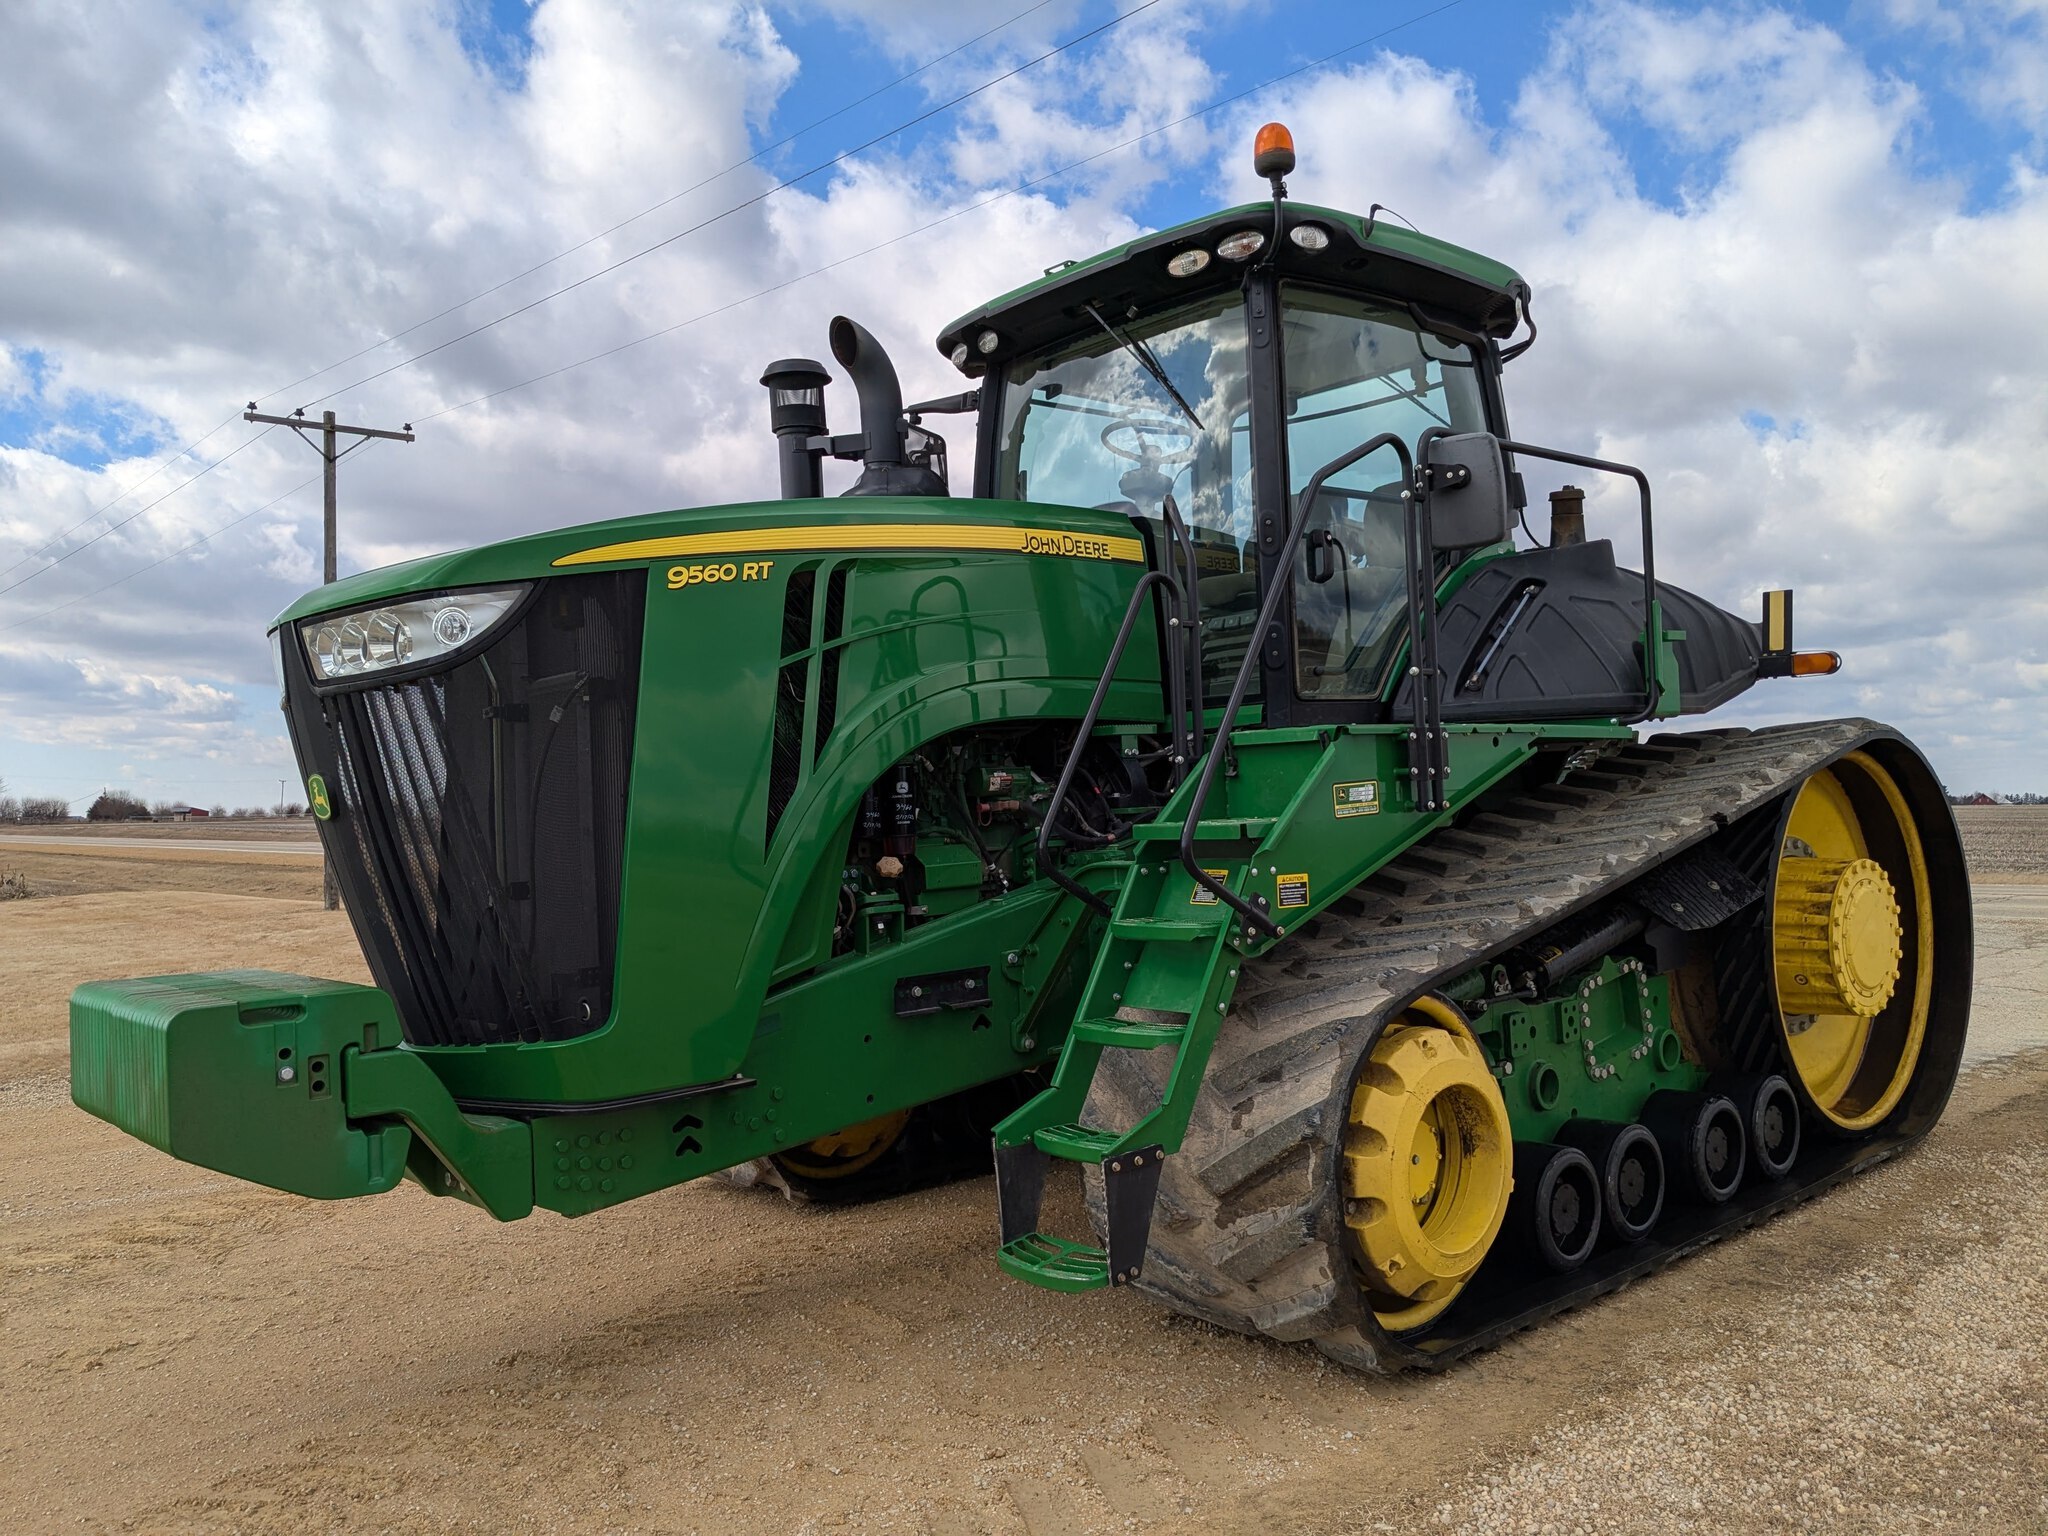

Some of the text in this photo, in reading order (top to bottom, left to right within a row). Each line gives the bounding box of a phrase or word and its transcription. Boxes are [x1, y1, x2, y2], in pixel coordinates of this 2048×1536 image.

[1021, 532, 1110, 557] JOHN DEERE
[667, 561, 774, 590] 9560 RT
